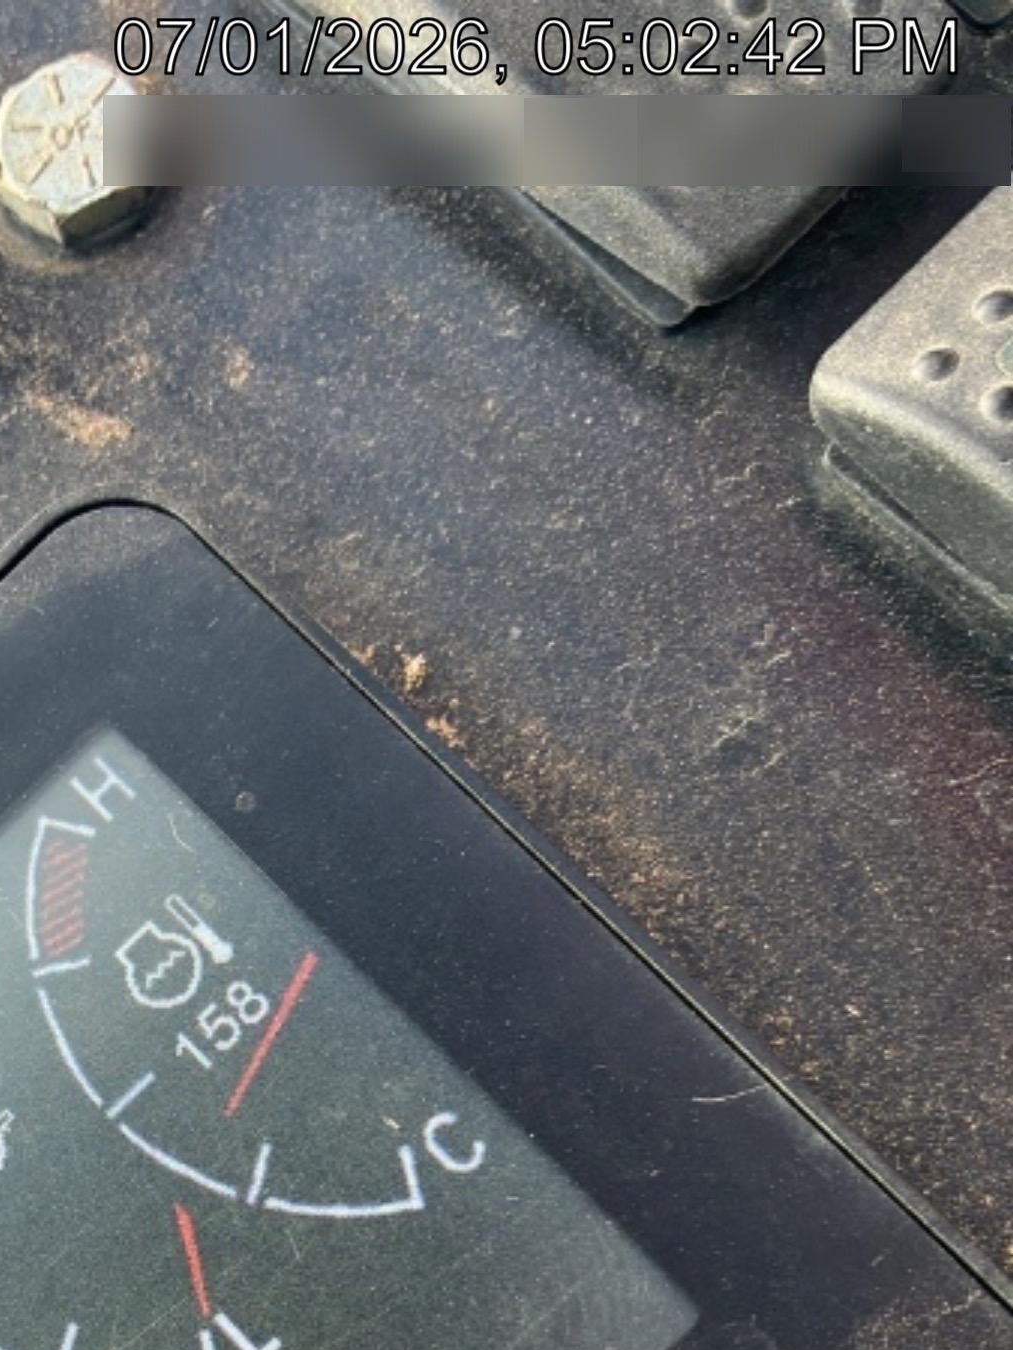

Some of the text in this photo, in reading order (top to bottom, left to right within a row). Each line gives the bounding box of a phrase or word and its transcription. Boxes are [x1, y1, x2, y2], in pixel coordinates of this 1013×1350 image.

[70, 756, 136, 822] H
[173, 980, 271, 1070] 158
[422, 1110, 486, 1173] C
